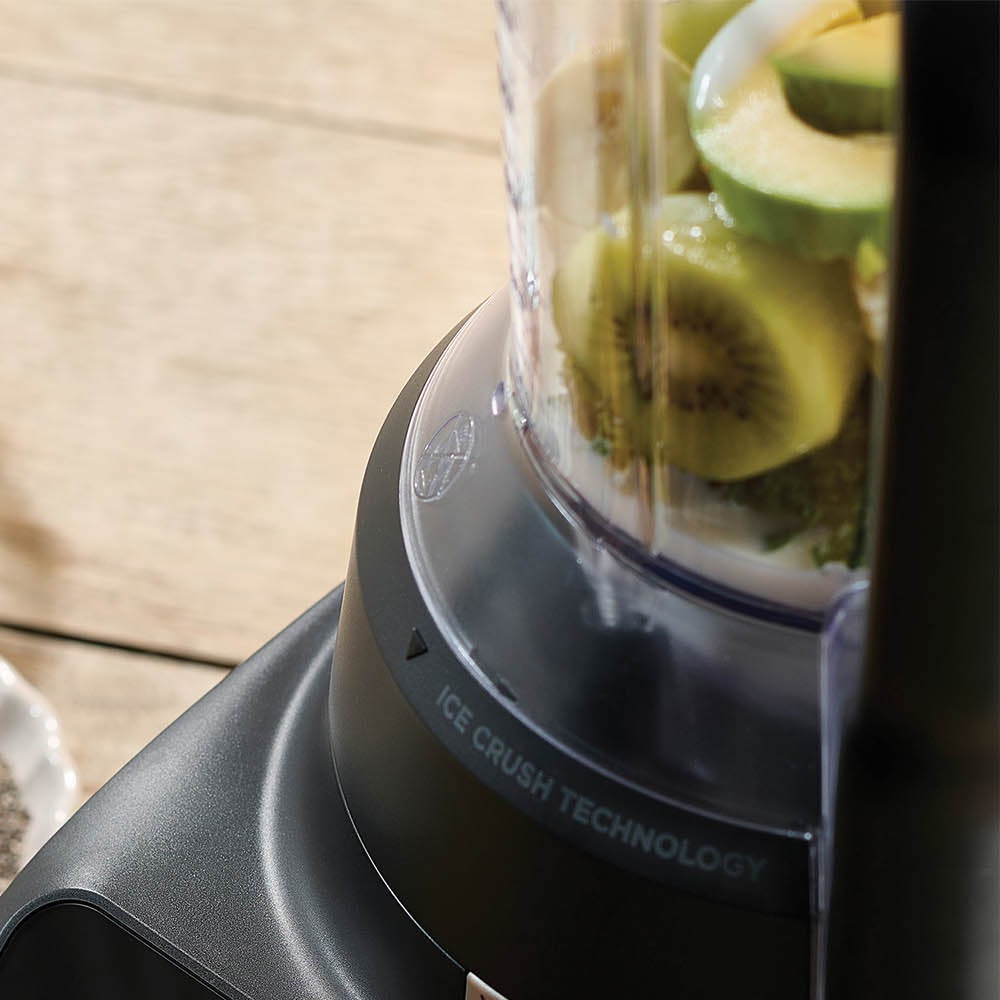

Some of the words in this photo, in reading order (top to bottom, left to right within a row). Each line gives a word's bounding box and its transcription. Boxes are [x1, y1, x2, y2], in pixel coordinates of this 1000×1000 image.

[436, 684, 475, 733] ICE
[472, 725, 556, 801] CRUSH
[558, 786, 768, 882] TECHNOLOGY
